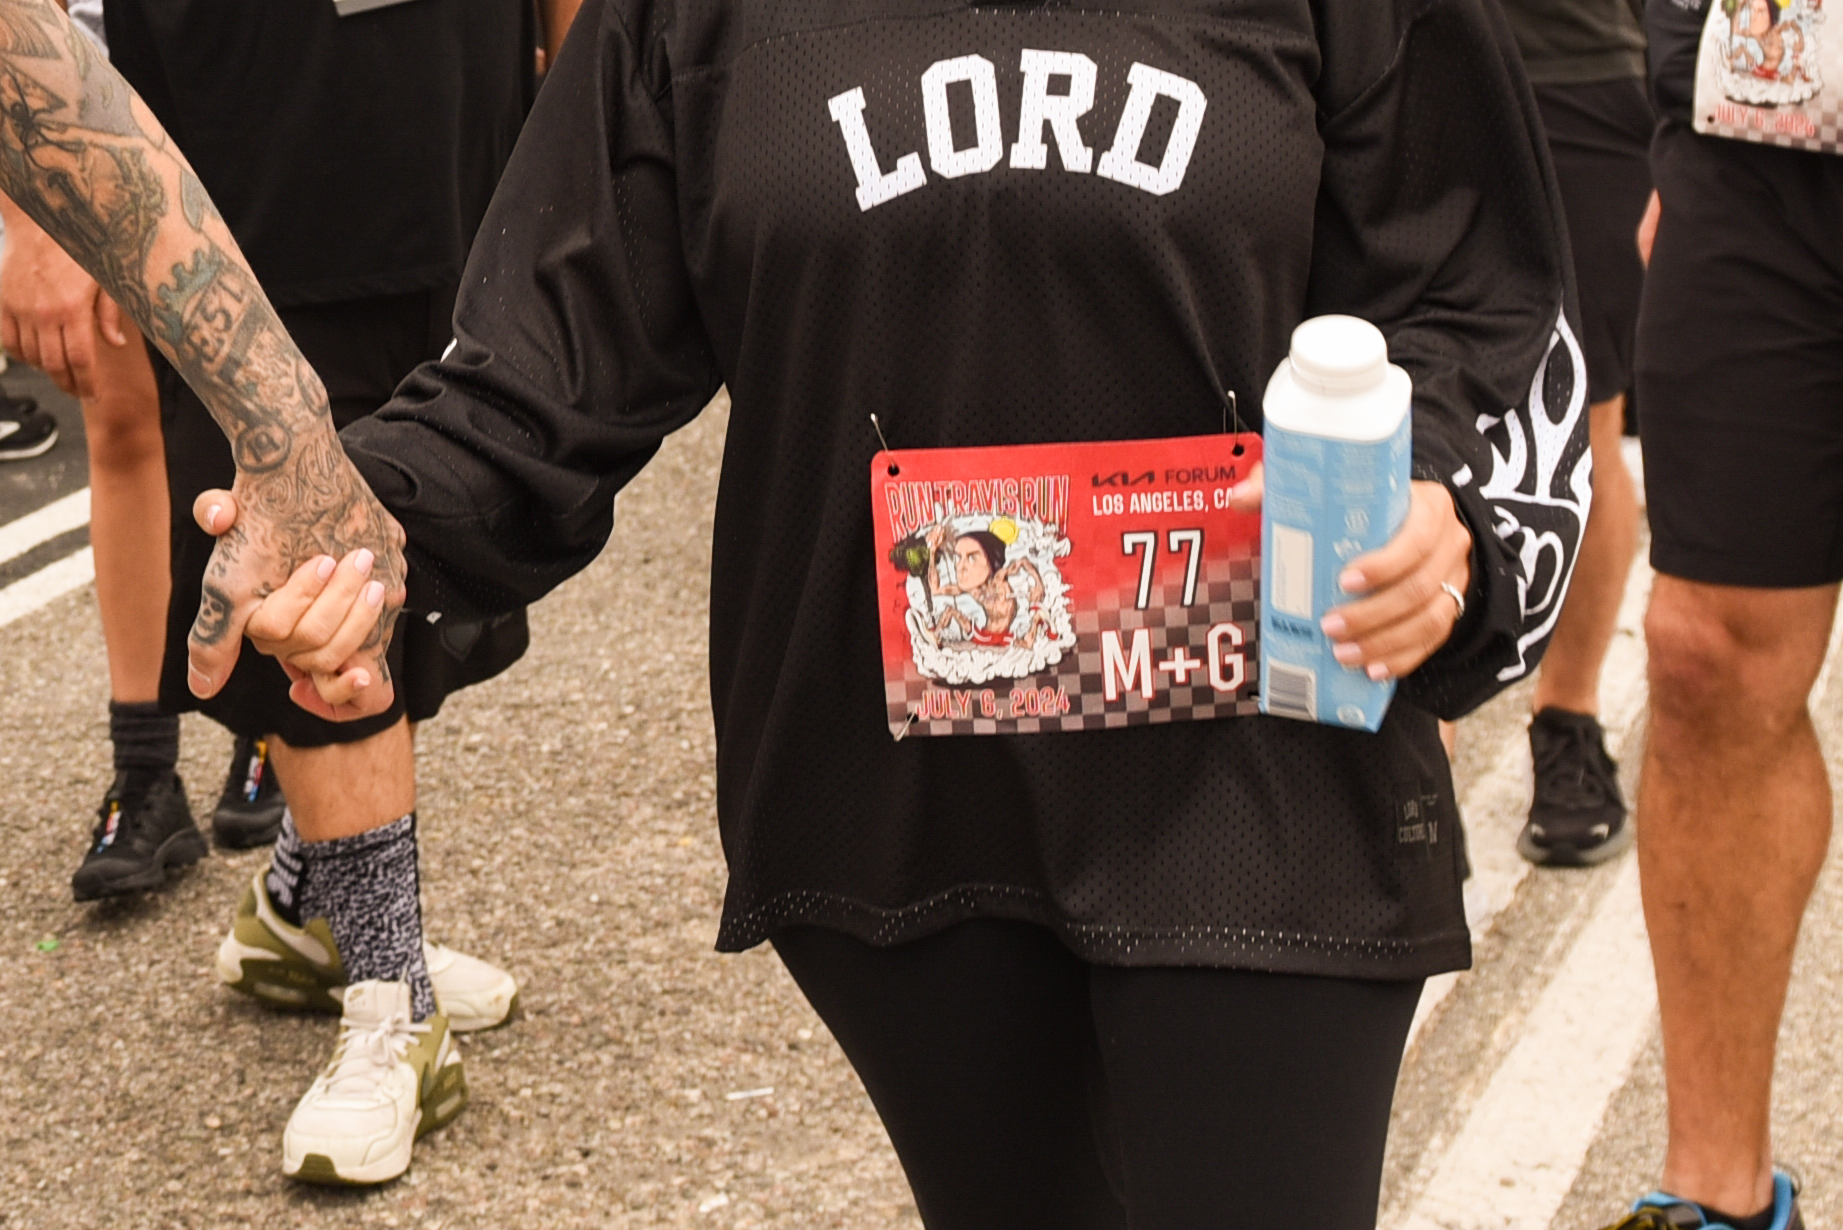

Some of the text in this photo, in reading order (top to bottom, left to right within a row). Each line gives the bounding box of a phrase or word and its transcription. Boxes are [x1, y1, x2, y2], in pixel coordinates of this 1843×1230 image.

[827, 48, 1207, 212] LORD
[885, 474, 1070, 544] RUN TRAVIS RUN
[1092, 466, 1237, 488] KIA FORUM
[1092, 493, 1125, 516] LOS
[1129, 489, 1210, 514] ANGELES,
[1121, 527, 1205, 611] 77
[1101, 622, 1248, 702] M+G
[916, 685, 1072, 720] JULY 6, 2024
